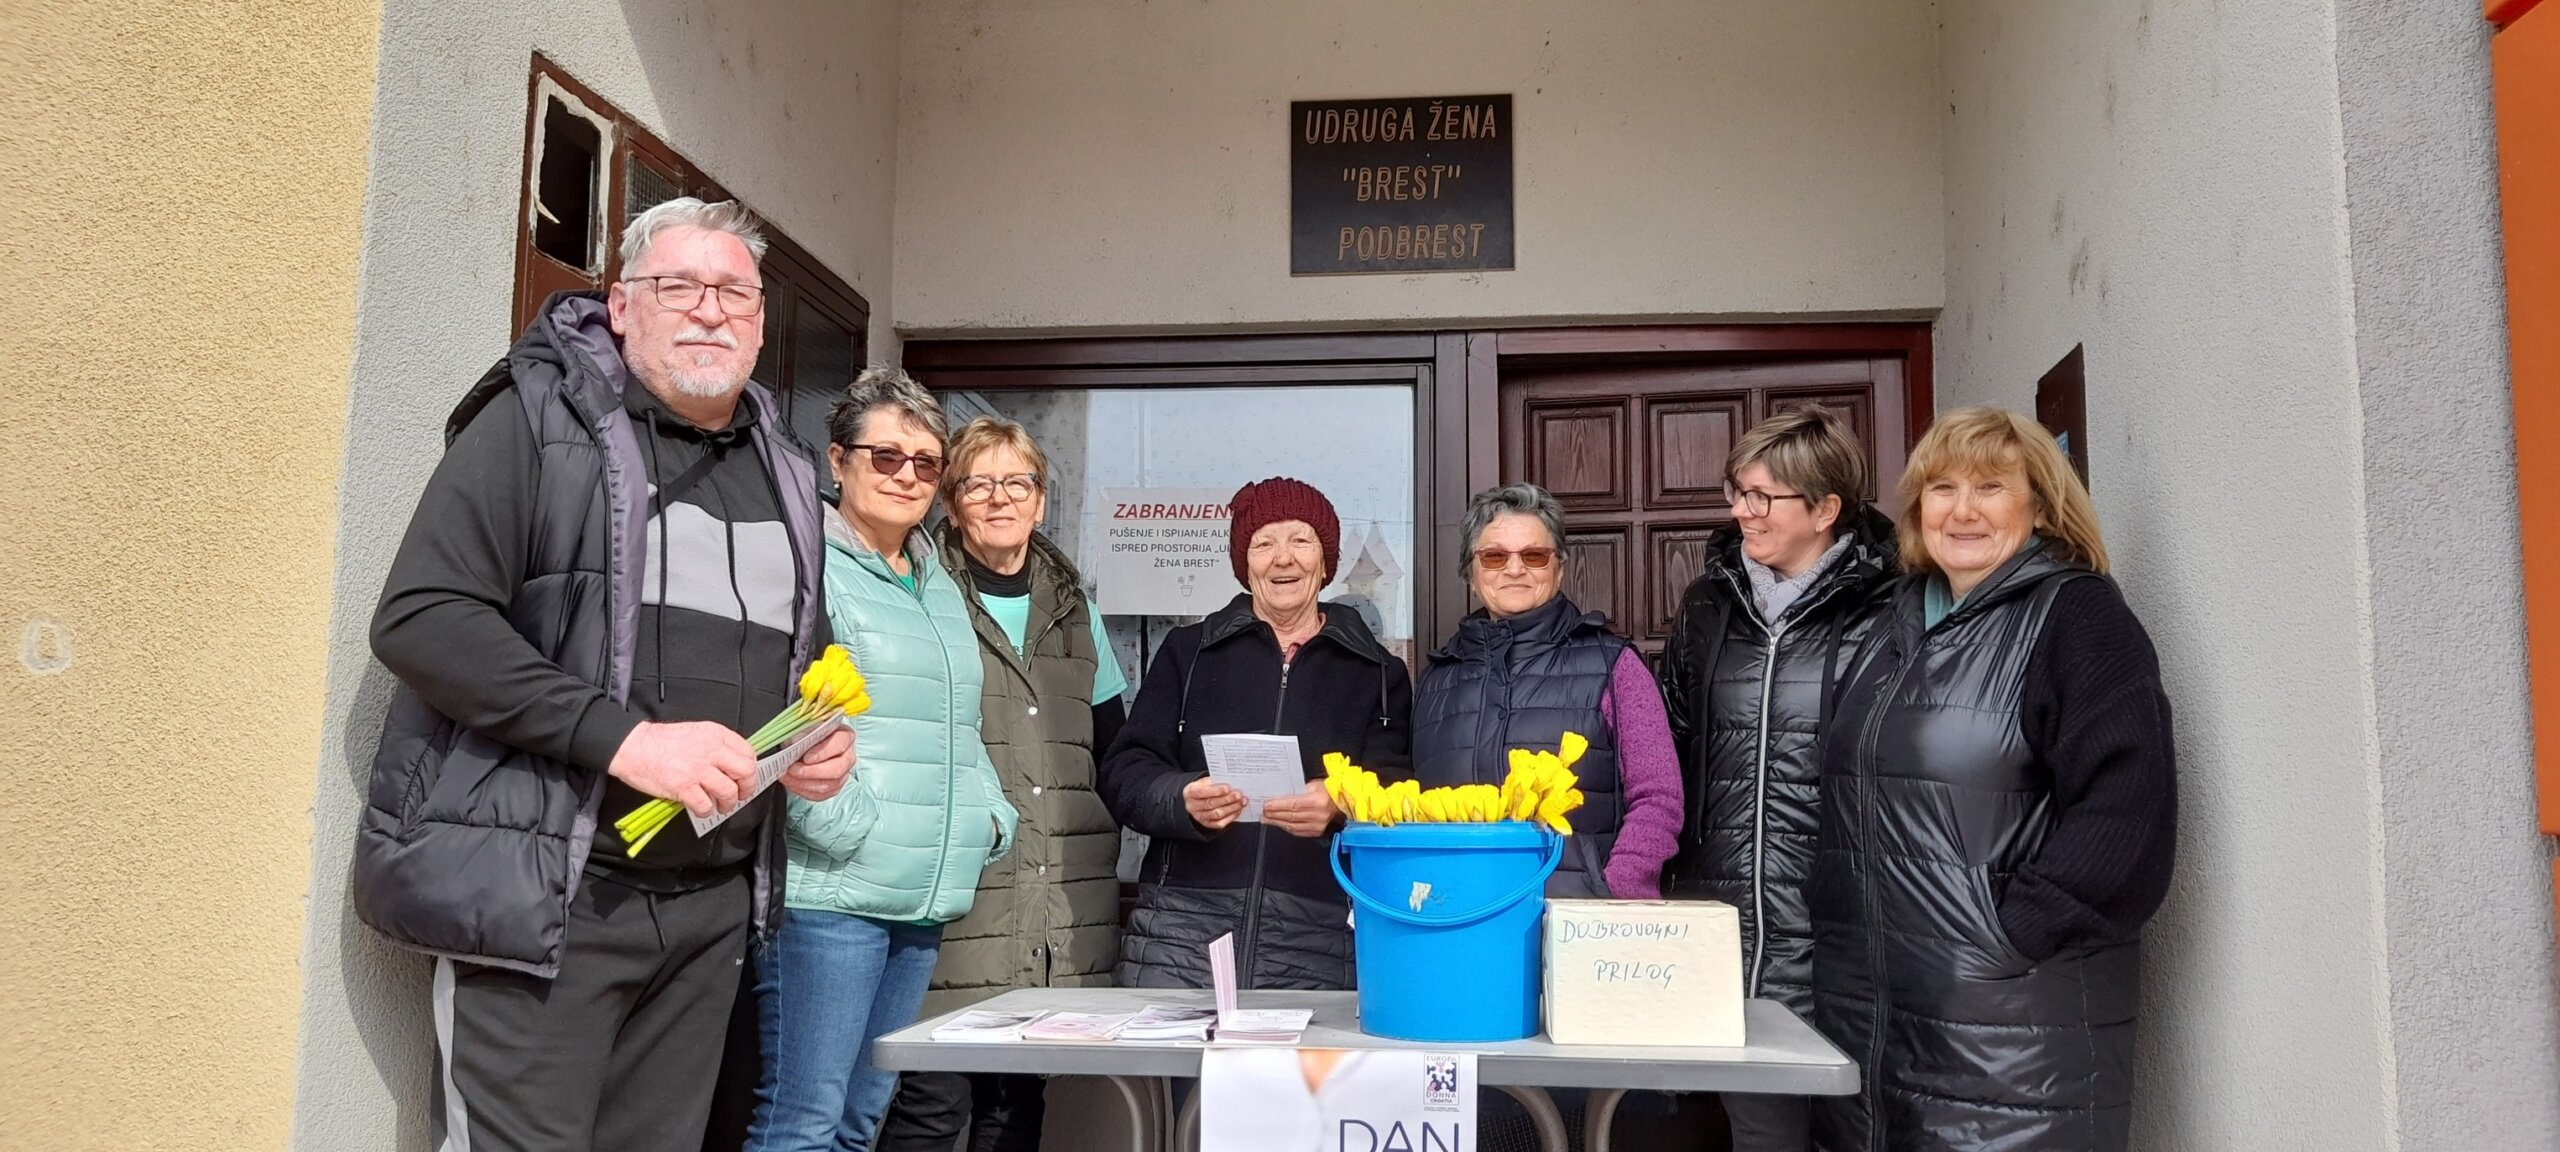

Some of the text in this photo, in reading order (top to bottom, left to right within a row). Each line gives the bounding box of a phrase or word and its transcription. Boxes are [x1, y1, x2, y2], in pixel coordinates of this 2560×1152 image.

[1305, 100, 1496, 144] UDRUGA ŽENA
[1343, 165, 1461, 201] "BREST"
[1338, 223, 1485, 261] PODBREST
[1113, 503, 1233, 520] ZABRANJEN
[1109, 527, 1154, 538] PUŠENJE
[1161, 529, 1208, 538] ISPIJANJE
[1211, 529, 1230, 538] ALK
[1111, 543, 1148, 553] ISPRED
[1150, 543, 1212, 553] PROSTORIJA
[1153, 557, 1181, 568] ŽENA
[1594, 959, 1676, 990] PRILOG
[1426, 1091, 1457, 1099] DONNA
[1339, 1119, 1460, 1152] DAN
